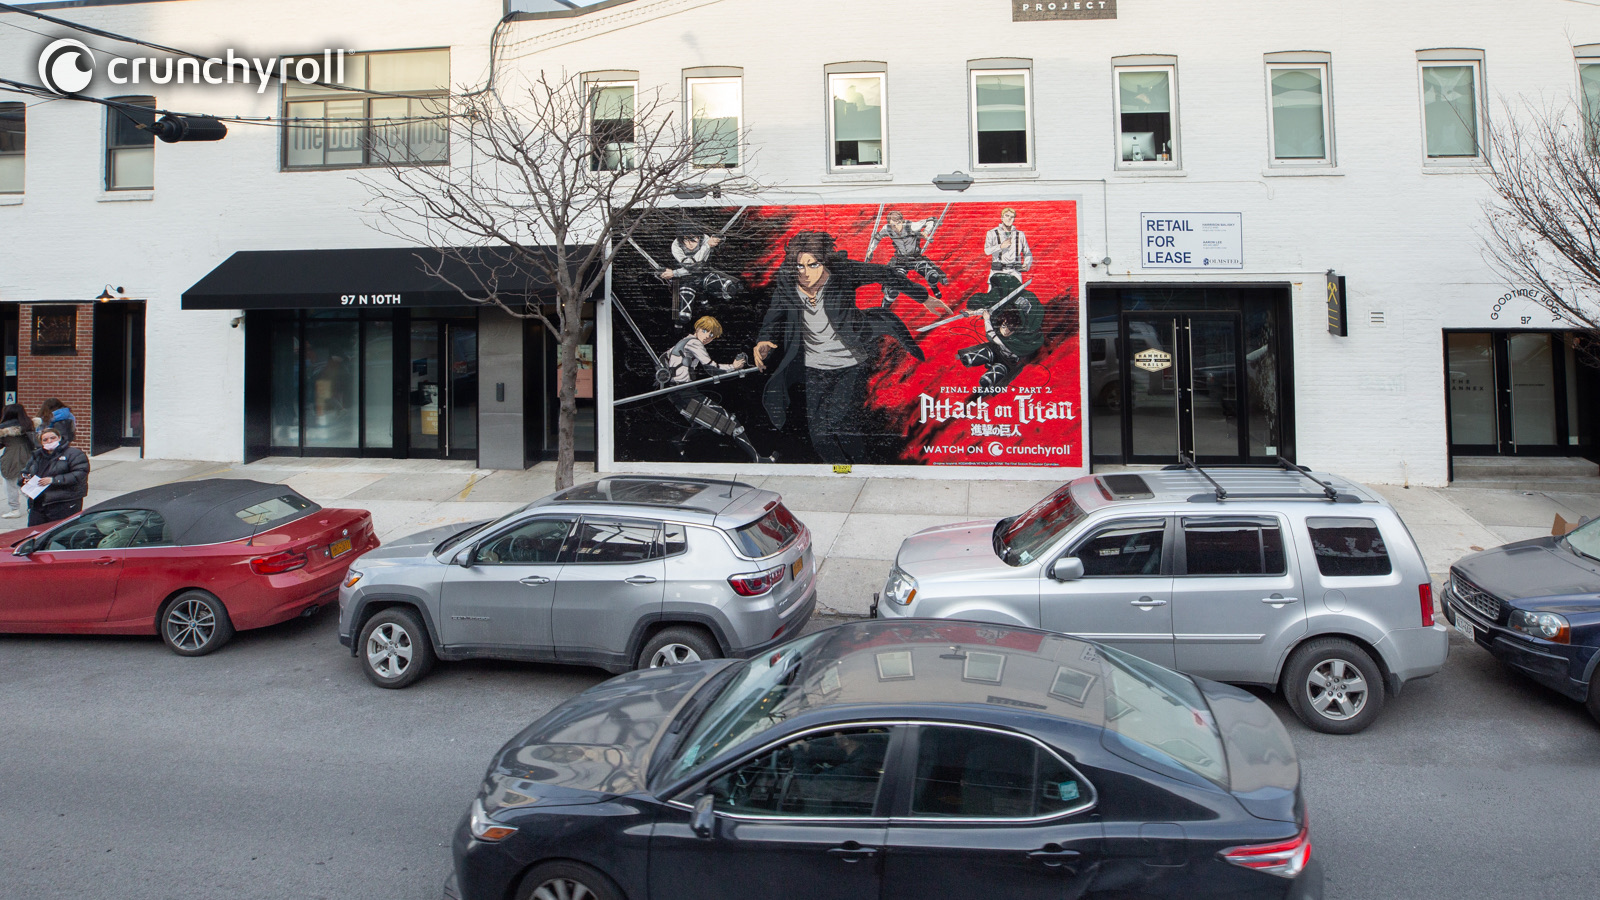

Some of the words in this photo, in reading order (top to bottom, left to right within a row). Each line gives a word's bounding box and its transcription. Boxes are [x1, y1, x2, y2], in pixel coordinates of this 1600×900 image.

[1022, 2, 1105, 11] PROJECT
[1146, 219, 1194, 232] RETAIL
[1147, 235, 1175, 247] FOR
[1147, 252, 1192, 264] LEASE
[340, 294, 356, 304] 97
[358, 294, 368, 304] N
[371, 294, 401, 304] 10TH
[1520, 316, 1532, 324] 97
[6, 393, 14, 402] A
[918, 392, 991, 424] Attack
[994, 404, 1012, 418] on
[1013, 394, 1076, 424] Titan
[970, 424, 1022, 437] 進撃の巨人
[924, 446, 964, 454] WATCH
[967, 446, 983, 454] ON
[1006, 444, 1070, 457] crunchyroll
